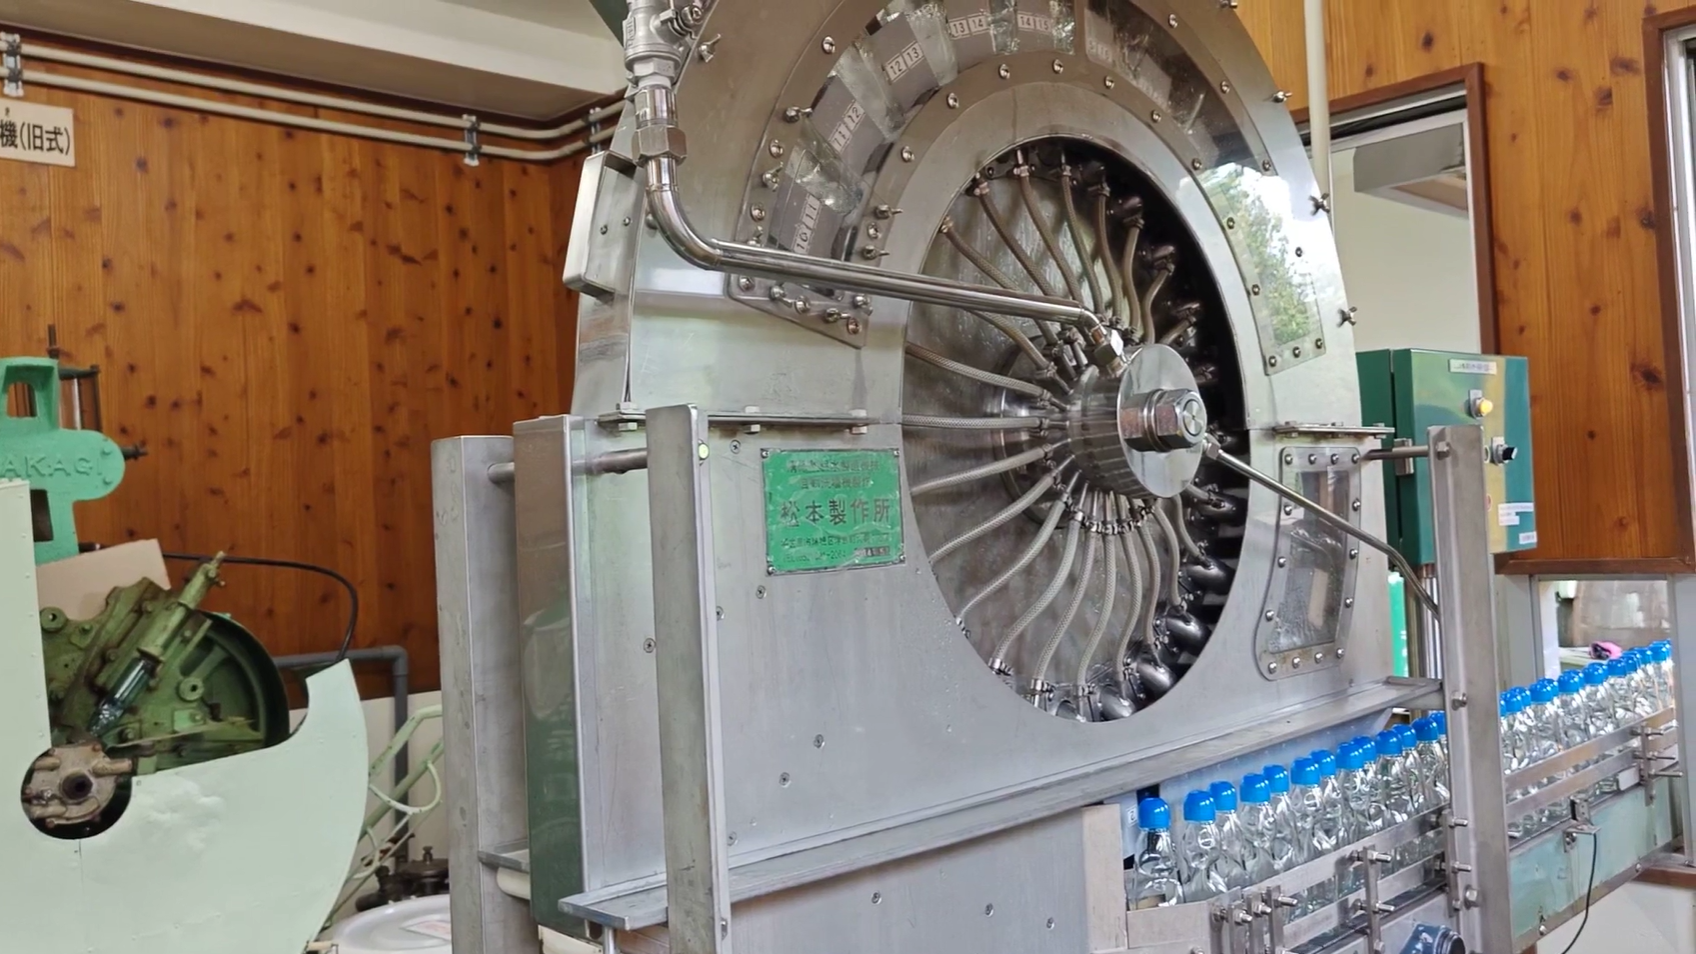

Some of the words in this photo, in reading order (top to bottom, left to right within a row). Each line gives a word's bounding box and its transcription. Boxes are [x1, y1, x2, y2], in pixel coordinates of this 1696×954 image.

[952, 22, 966, 34] 13
[971, 18, 984, 29] 14
[1019, 15, 1032, 26] 14
[890, 60, 903, 75] 12
[906, 46, 920, 62] 13
[847, 106, 861, 123] 12
[780, 498, 891, 528] 松本製作所
